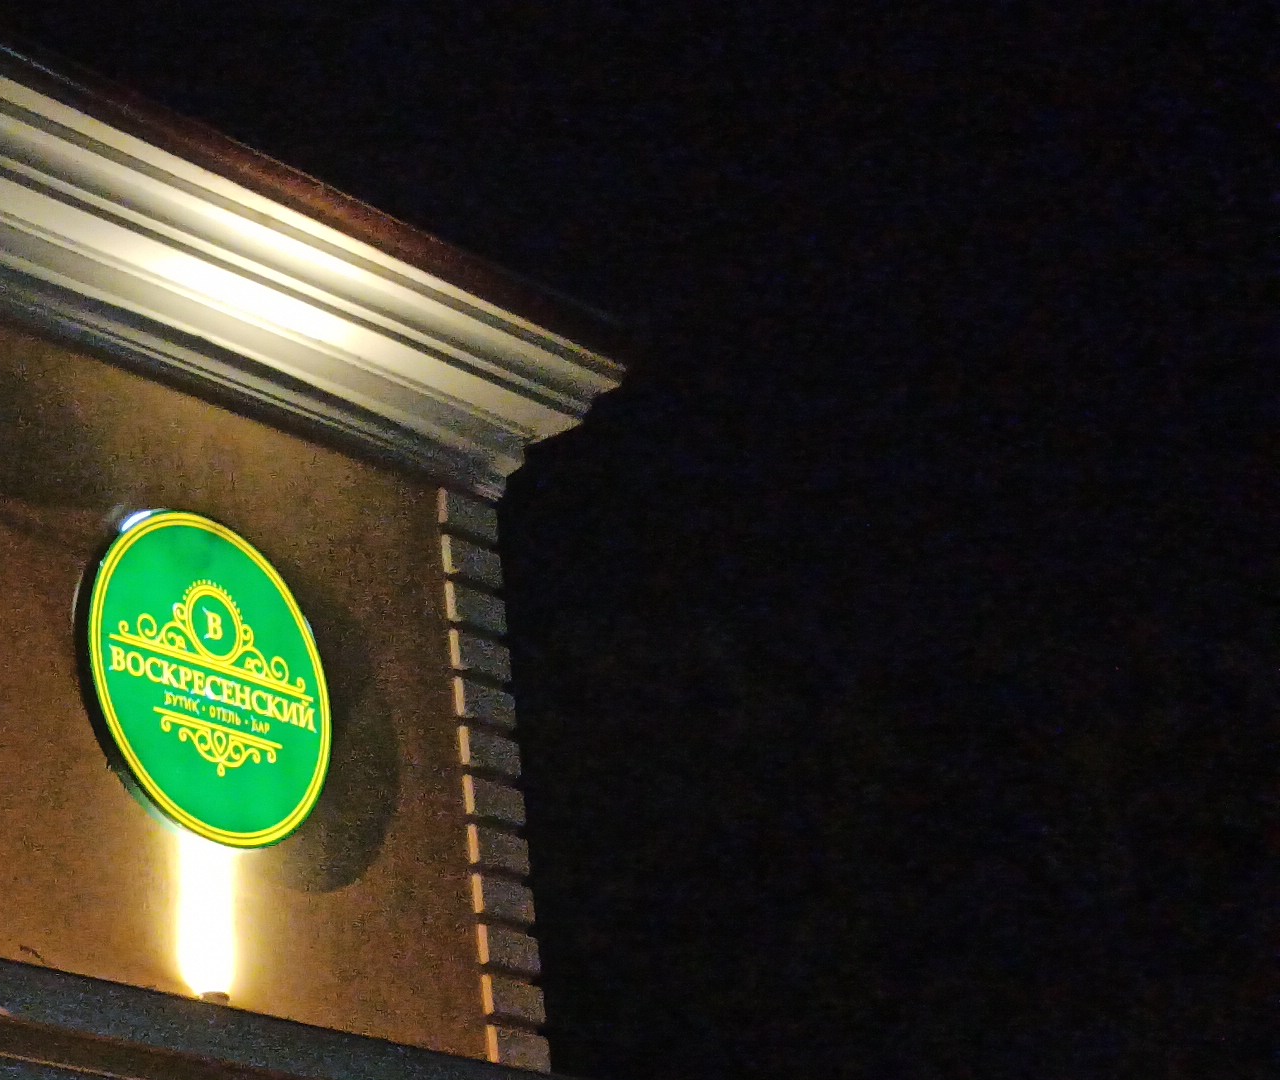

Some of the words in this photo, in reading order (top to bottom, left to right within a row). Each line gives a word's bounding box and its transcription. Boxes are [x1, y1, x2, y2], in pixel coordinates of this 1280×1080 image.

[203, 605, 224, 642] В
[108, 643, 317, 734] ВОСКРЕСЕНСКИЙ
[164, 690, 200, 716] БУТИК
[208, 705, 242, 726] ОТЕЛЬ
[250, 716, 271, 734] БАР
